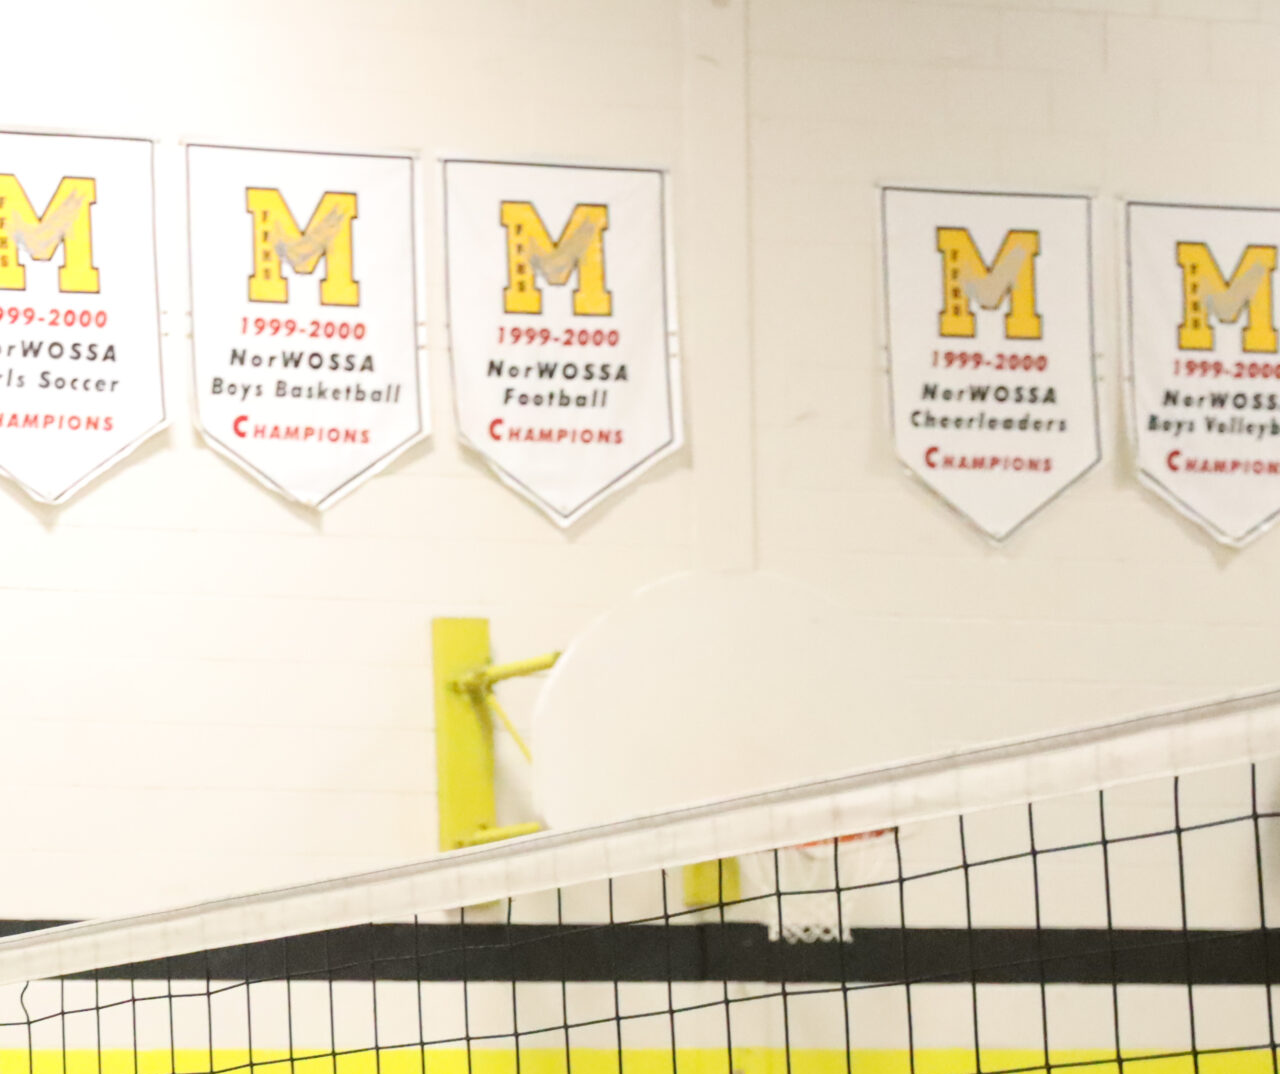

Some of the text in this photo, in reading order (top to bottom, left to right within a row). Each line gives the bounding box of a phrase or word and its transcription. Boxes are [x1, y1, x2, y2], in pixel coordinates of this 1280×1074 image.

[245, 187, 360, 307] M
[500, 200, 613, 317] M
[936, 226, 1043, 340] M
[1176, 241, 1279, 354] M
[242, 317, 366, 341] 1999-2000
[499, 326, 620, 347] 1999-2000
[230, 348, 375, 372] NorWOSSA
[487, 360, 629, 382] NorWOSSA
[932, 350, 1048, 372] 1999-2000
[39, 371, 119, 392] Soccer
[211, 377, 401, 403] Boys Basketball
[503, 388, 608, 408] Football
[922, 383, 1057, 404] NorWOSSA
[1162, 389, 1280, 411] NorWOSS
[910, 410, 1066, 432] Cheerleaders
[1147, 414, 1195, 437] Boys
